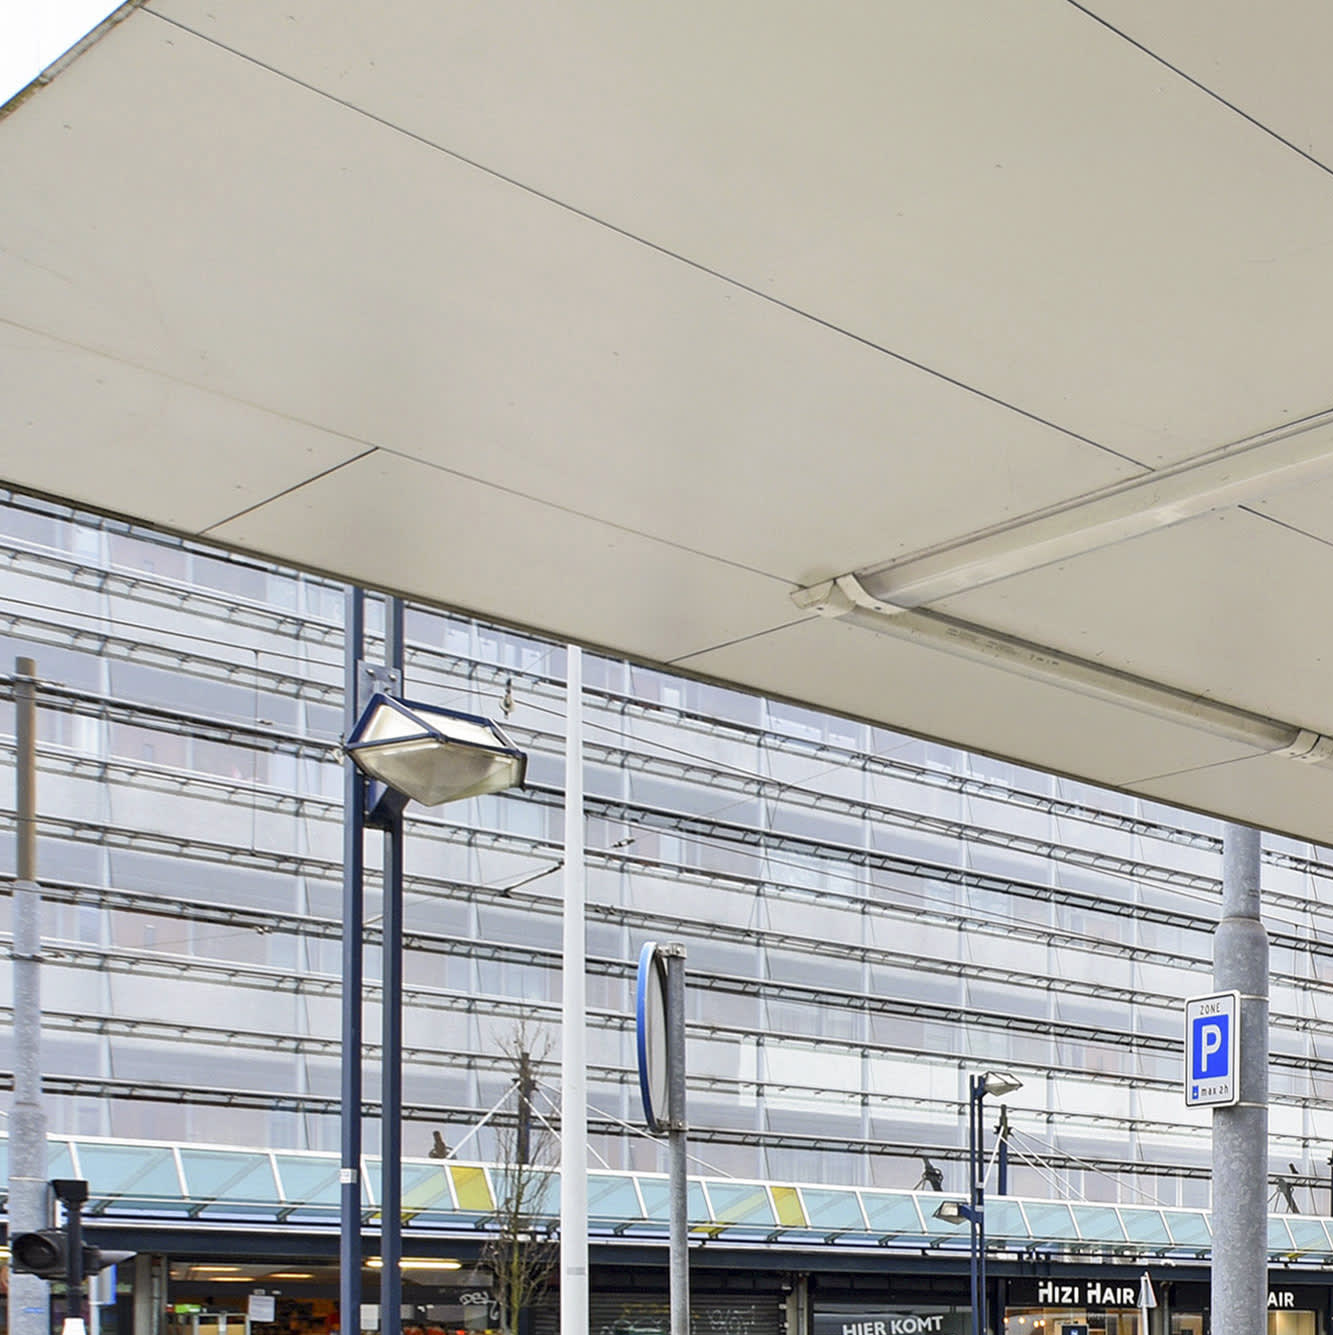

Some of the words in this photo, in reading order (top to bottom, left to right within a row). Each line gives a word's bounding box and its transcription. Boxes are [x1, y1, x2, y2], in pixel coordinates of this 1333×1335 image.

[1200, 1003, 1221, 1015] ZONE
[1201, 1024, 1222, 1072] P
[1201, 1087, 1217, 1097] max
[1038, 1281, 1079, 1303] HIZI
[1087, 1282, 1135, 1304] HAIR
[1266, 1291, 1295, 1308] AIR
[891, 1315, 944, 1335] KOMT
